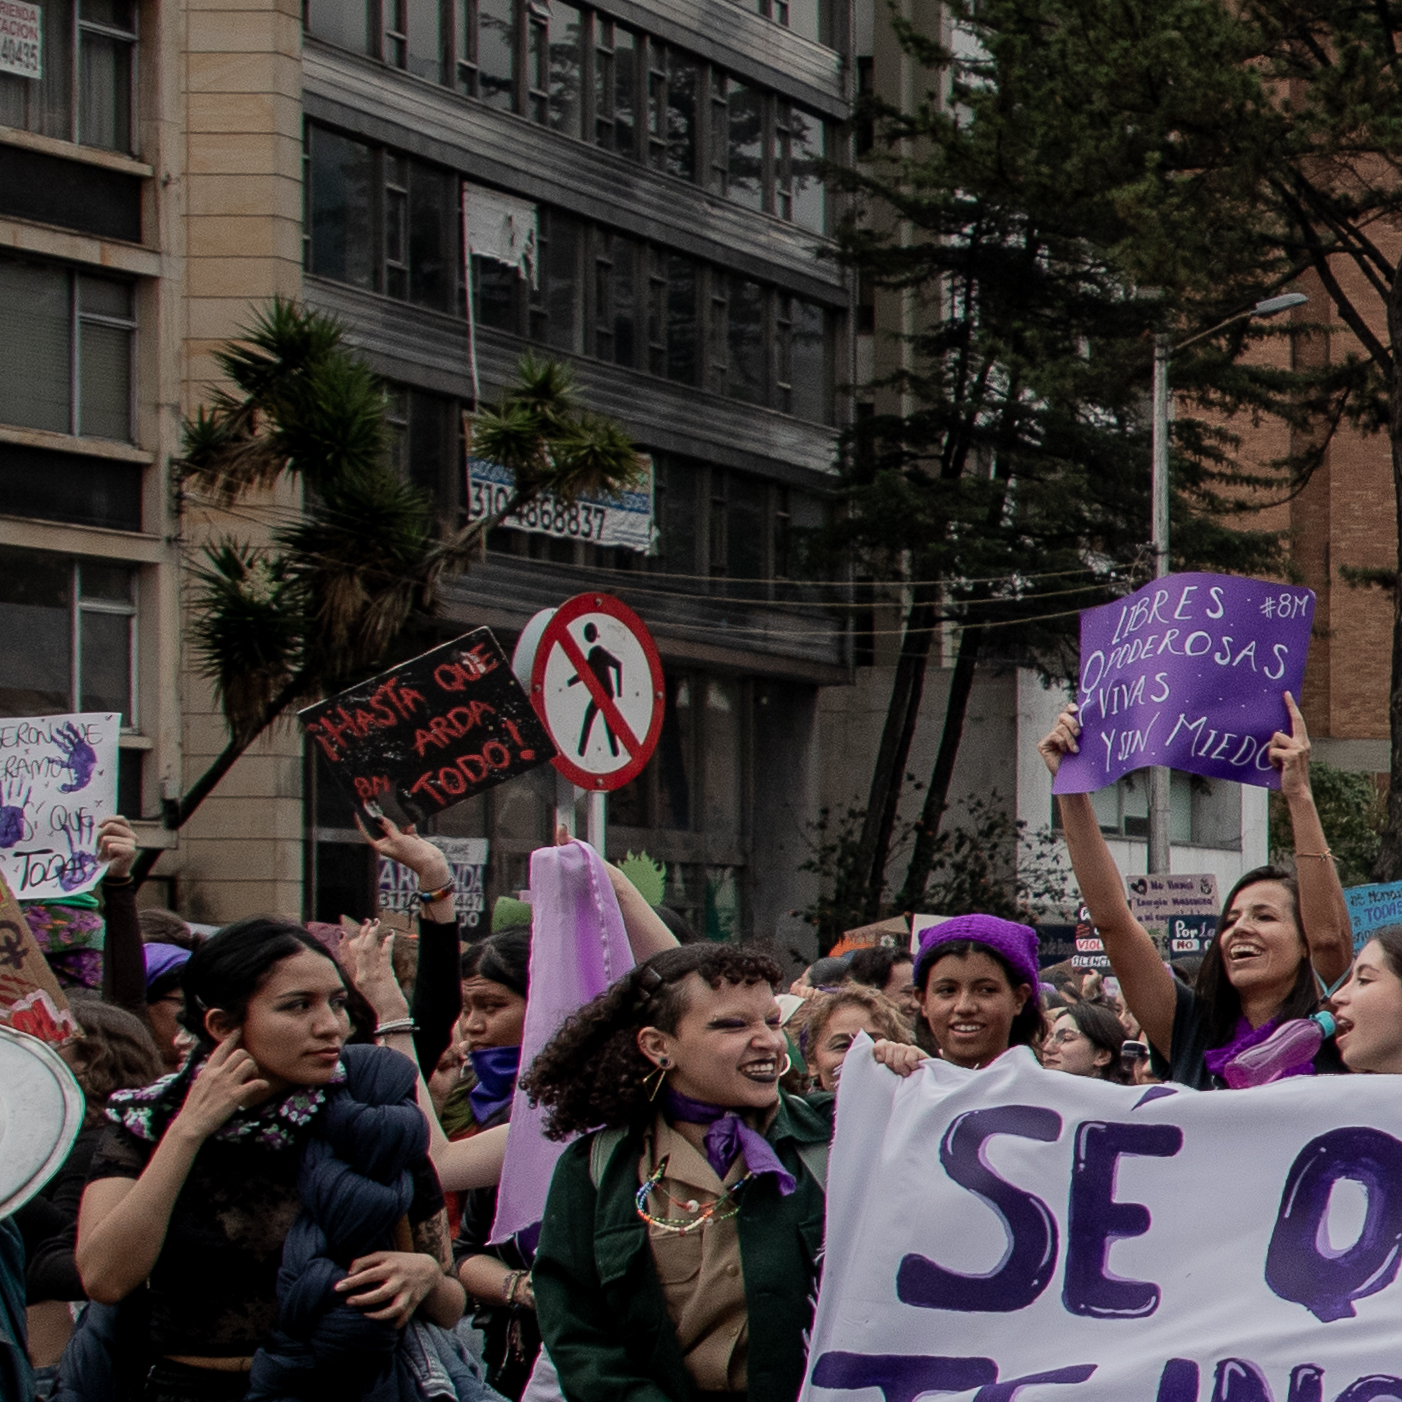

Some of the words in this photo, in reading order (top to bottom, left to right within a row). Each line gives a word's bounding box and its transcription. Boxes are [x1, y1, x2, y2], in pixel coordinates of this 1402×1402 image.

[1111, 586, 1225, 646] LIBRES
[1260, 593, 1309, 619] #8M
[433, 642, 499, 692] QUE
[1099, 671, 1170, 719] VIVAS
[412, 700, 497, 757] ARDA
[353, 774, 391, 799] 8M
[1078, 940, 1102, 951] VIOL
[1175, 919, 1198, 938] Por
[1176, 940, 1194, 950] NO
[1072, 955, 1110, 967] SILENC
[896, 1085, 1183, 1320] SÉ
